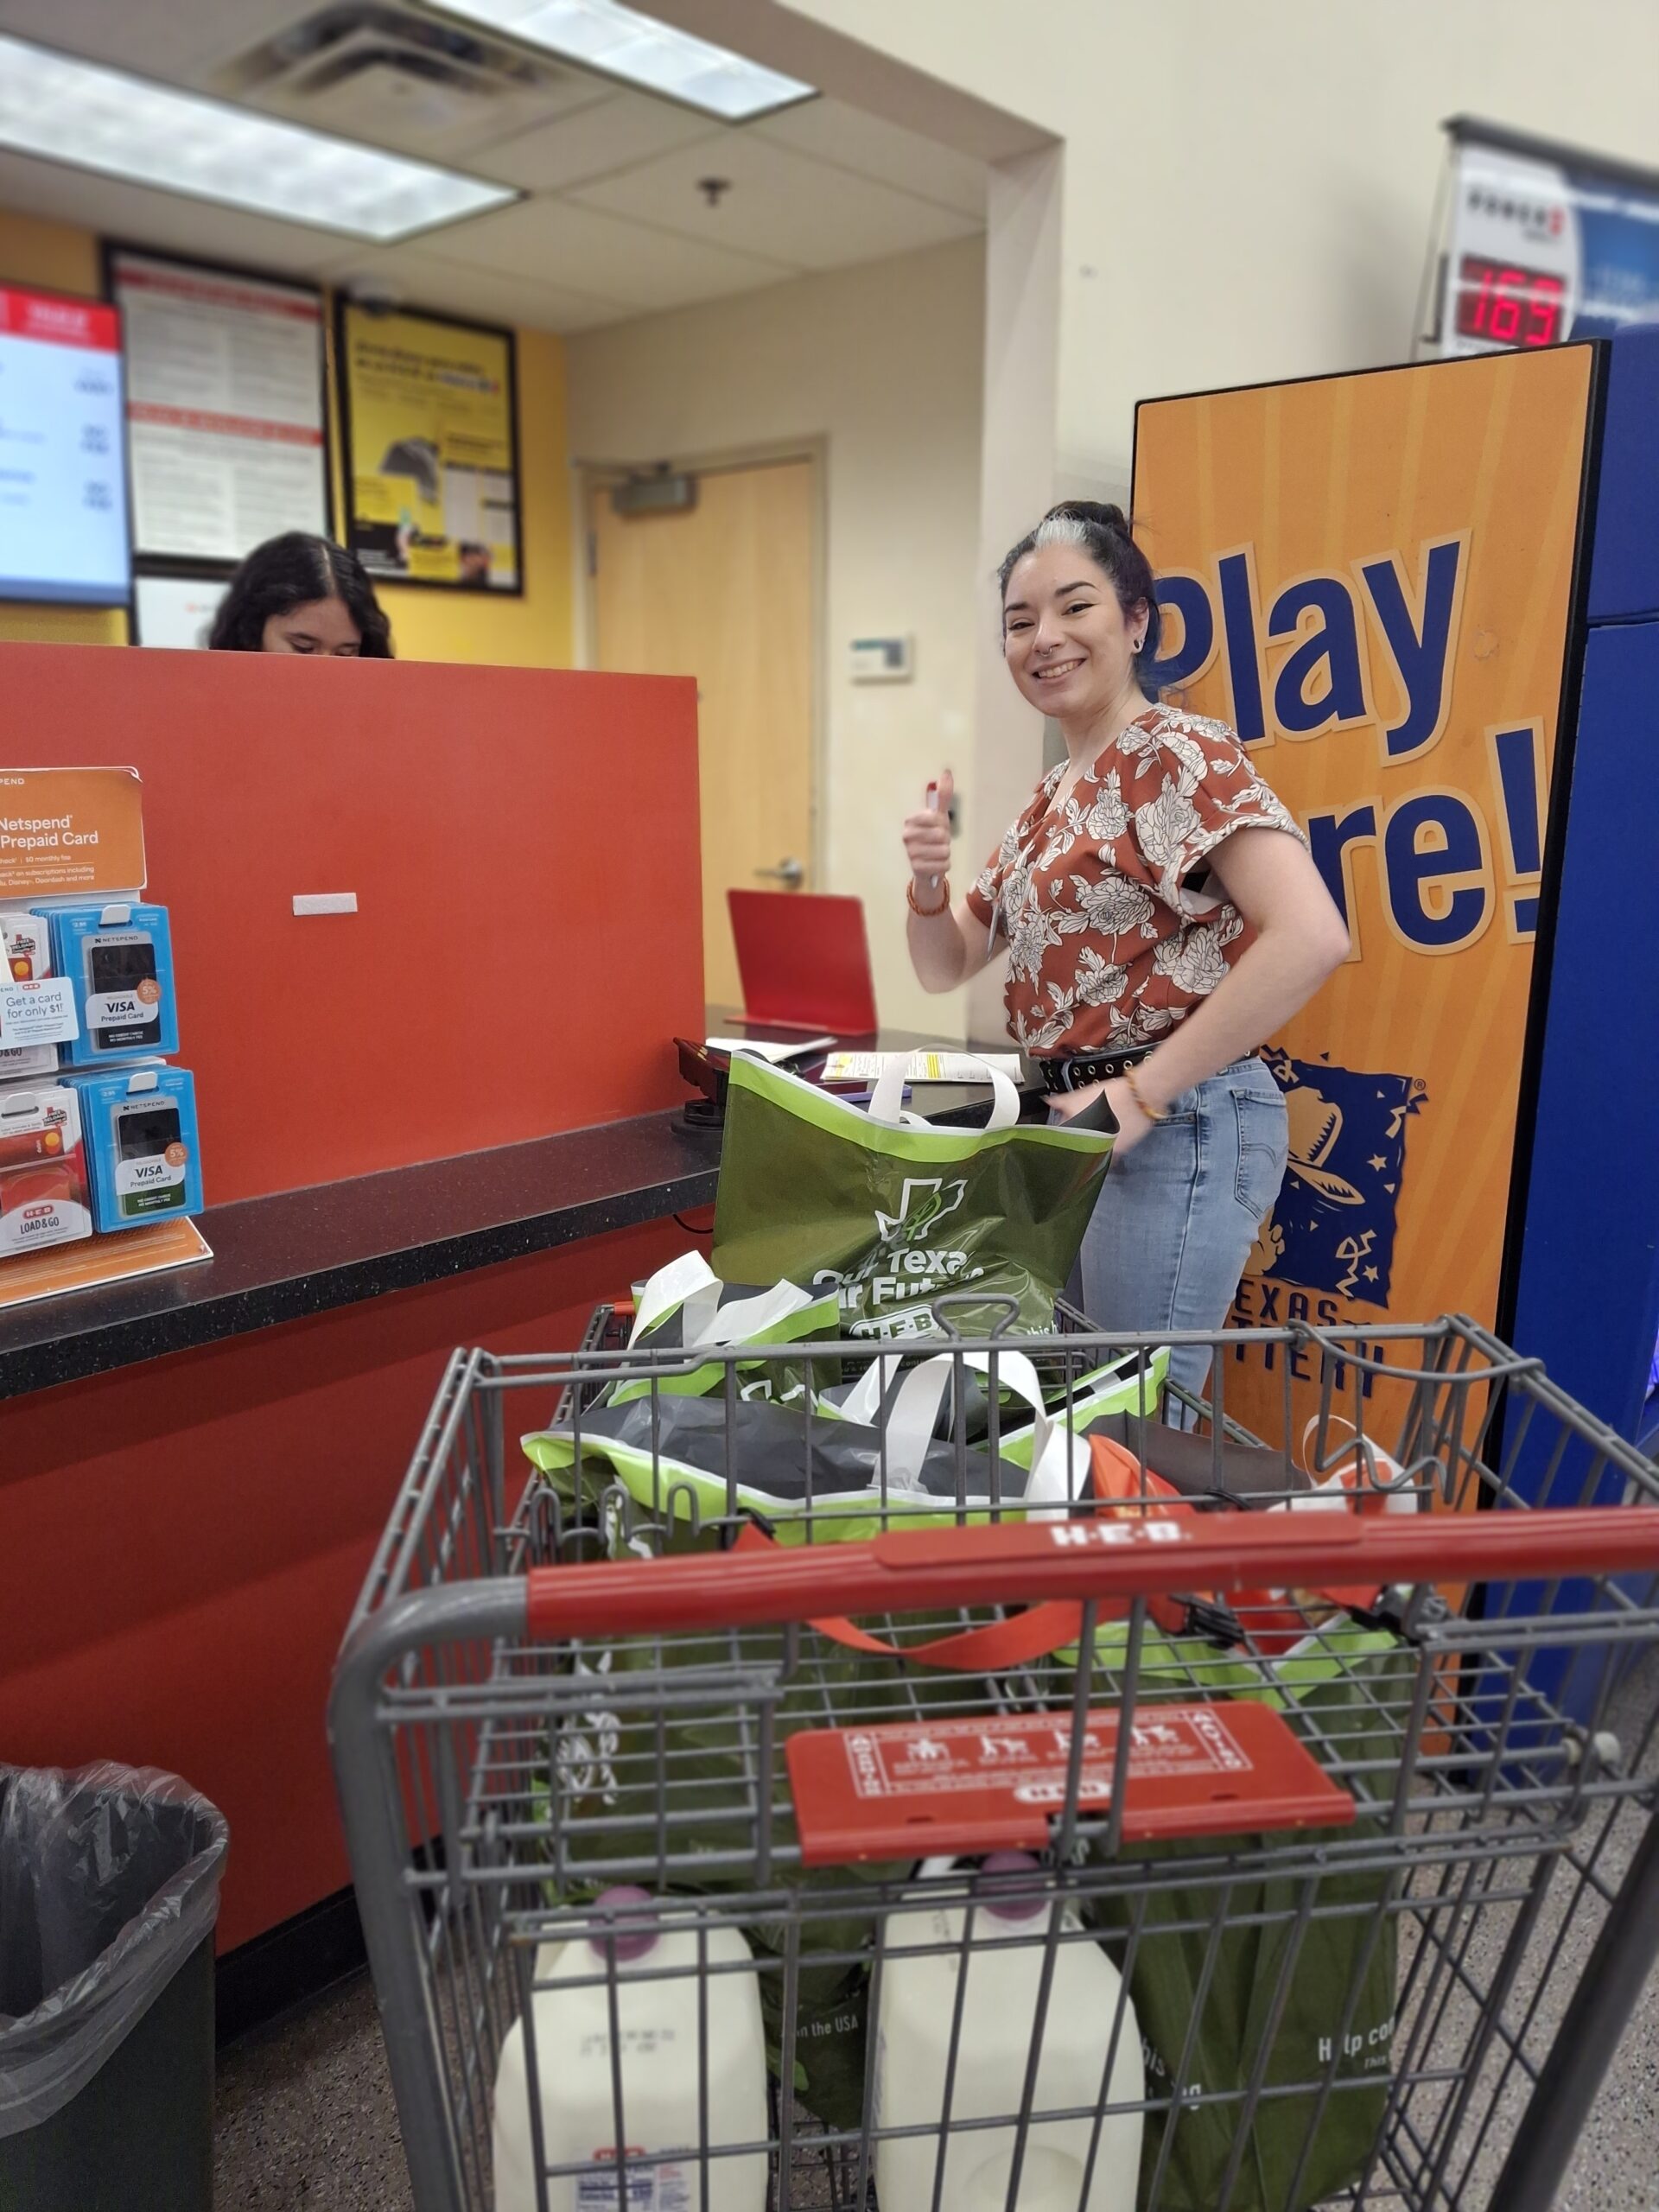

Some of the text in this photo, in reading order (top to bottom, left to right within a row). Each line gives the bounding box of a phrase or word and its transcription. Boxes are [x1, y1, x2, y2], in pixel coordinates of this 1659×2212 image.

[1145, 541, 1461, 757] Play
[1, 830, 99, 850] Prepaid Card
[1307, 728, 1541, 946] re!
[25, 868, 67, 876] subscriptions
[6, 996, 26, 1007] Get
[37, 992, 61, 1003] card
[105, 1001, 135, 1013] VISA
[7, 1008, 22, 1019] for
[25, 1006, 48, 1017] only
[101, 1014, 127, 1022] Prepaid
[130, 1101, 165, 1109] NETSPEND
[169, 1148, 184, 1158] 5%
[135, 1165, 162, 1178] VISA
[130, 1179, 155, 1188] Prepaid
[887, 1248, 968, 1274] Texa
[1235, 1279, 1338, 1326] EXAS
[1231, 1315, 1386, 1398] TTERY
[811, 2022, 831, 2037] the
[835, 2014, 859, 2032] USA
[1319, 2034, 1363, 2063] Hlp
